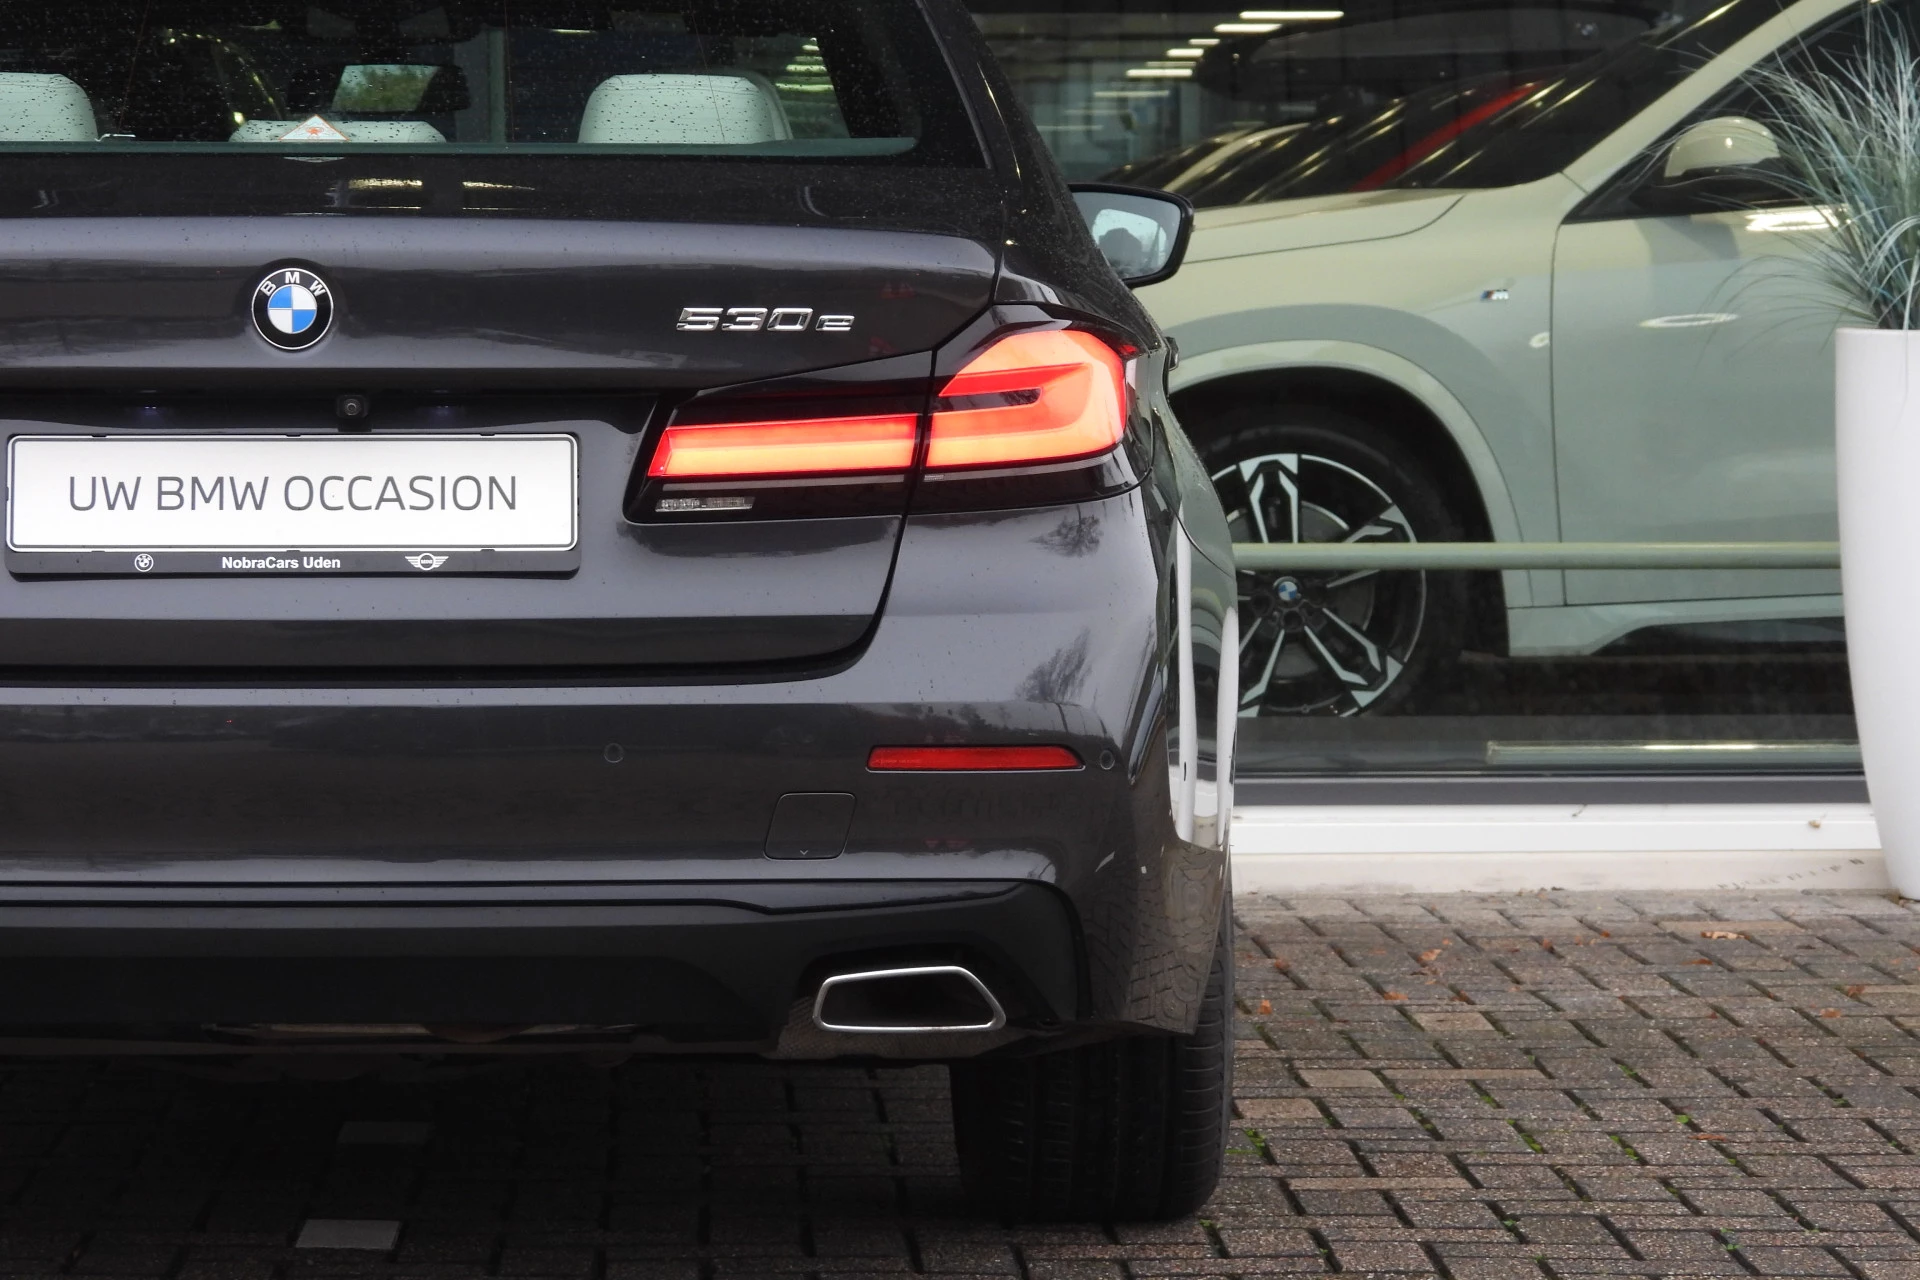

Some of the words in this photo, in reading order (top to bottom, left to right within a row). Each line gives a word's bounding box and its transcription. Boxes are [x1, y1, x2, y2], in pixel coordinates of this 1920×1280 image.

[260, 271, 326, 297] BMW
[69, 476, 142, 511] UW
[157, 476, 269, 511] BMW
[284, 475, 517, 511] OCCASION
[221, 556, 299, 569] NobraCars
[303, 556, 341, 569] Uden
